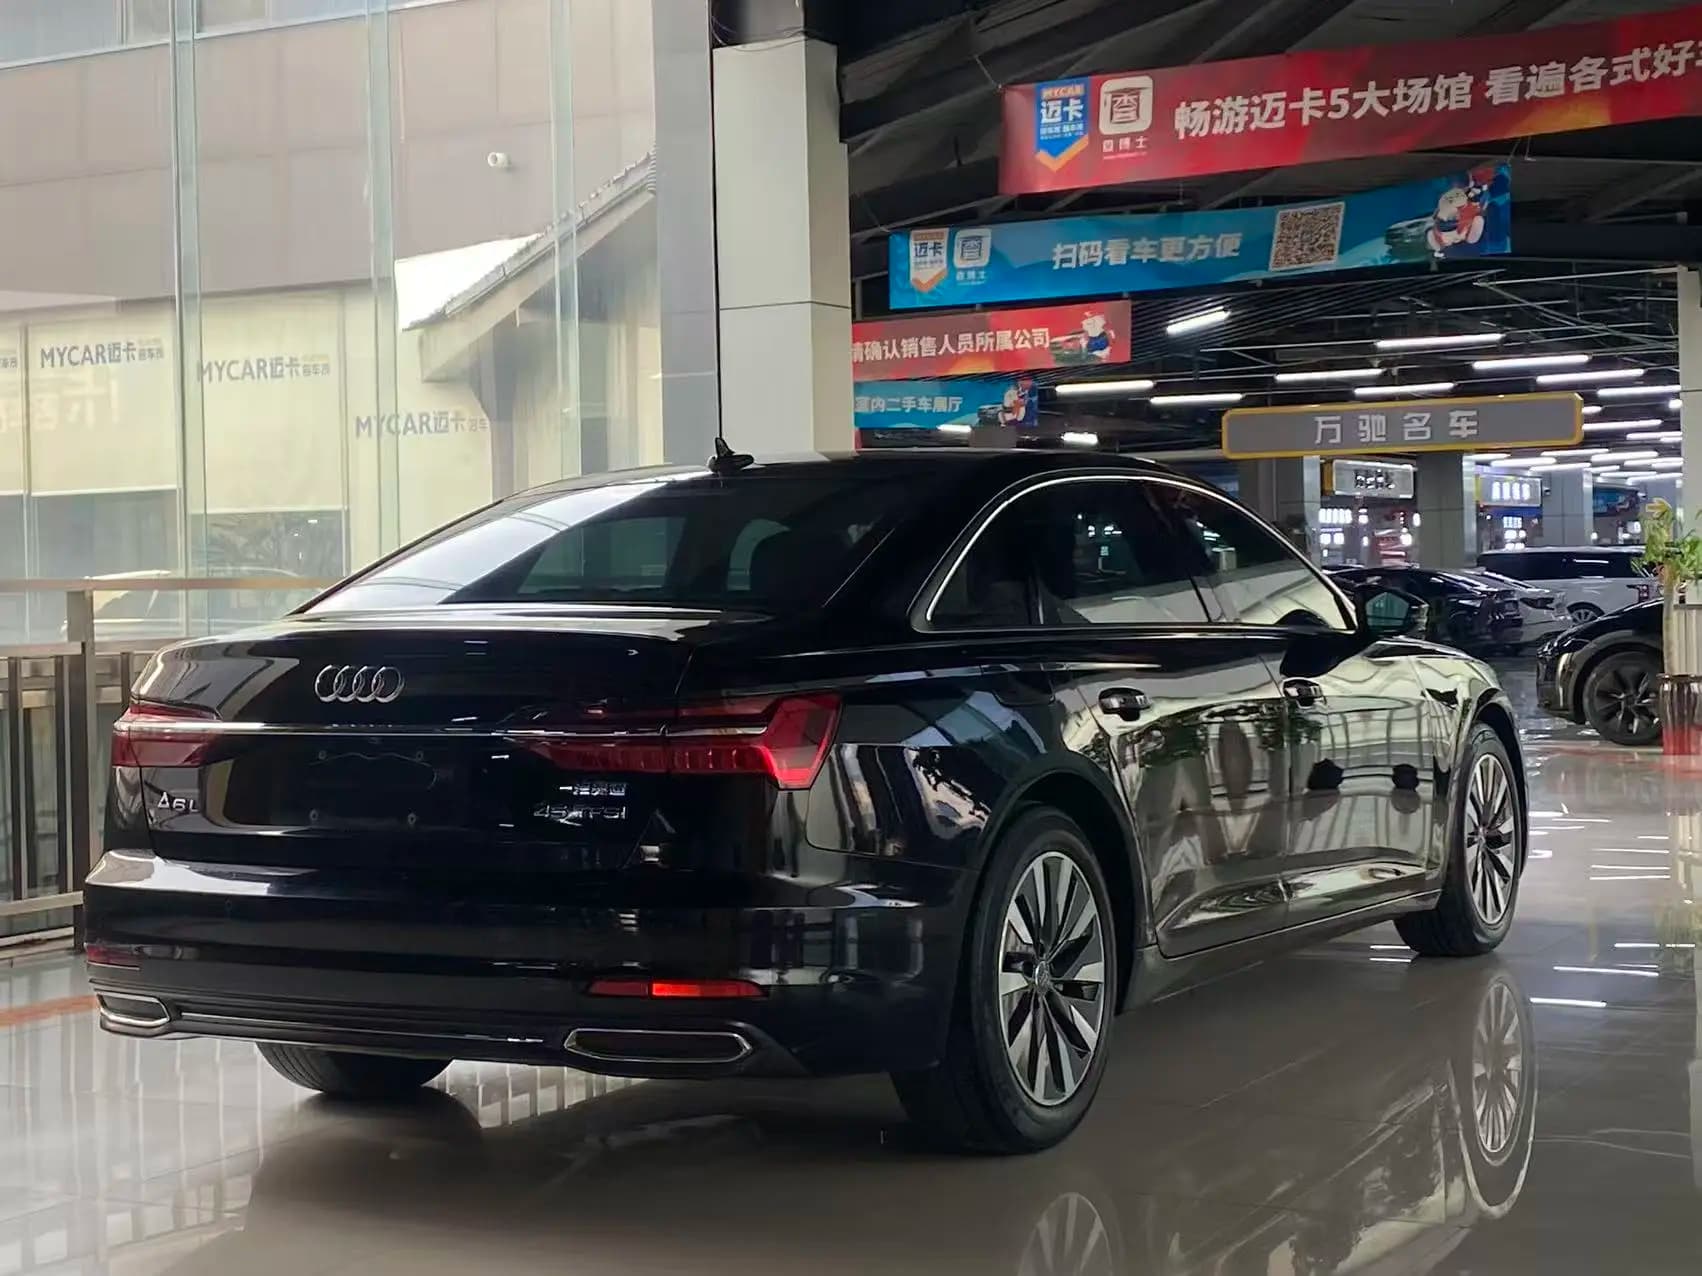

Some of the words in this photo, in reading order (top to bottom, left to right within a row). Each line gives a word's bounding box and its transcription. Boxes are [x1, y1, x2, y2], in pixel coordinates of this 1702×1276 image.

[1174, 72, 1474, 140] 畅游迈卡5大场馆
[1485, 39, 1702, 105] 看遍各式好
[1040, 98, 1084, 124] 迈卡
[914, 241, 944, 258] 迈卡
[1053, 233, 1242, 270] 扫码看车更方便
[1315, 410, 1478, 444] 万驰名车
[157, 791, 199, 812] A6L
